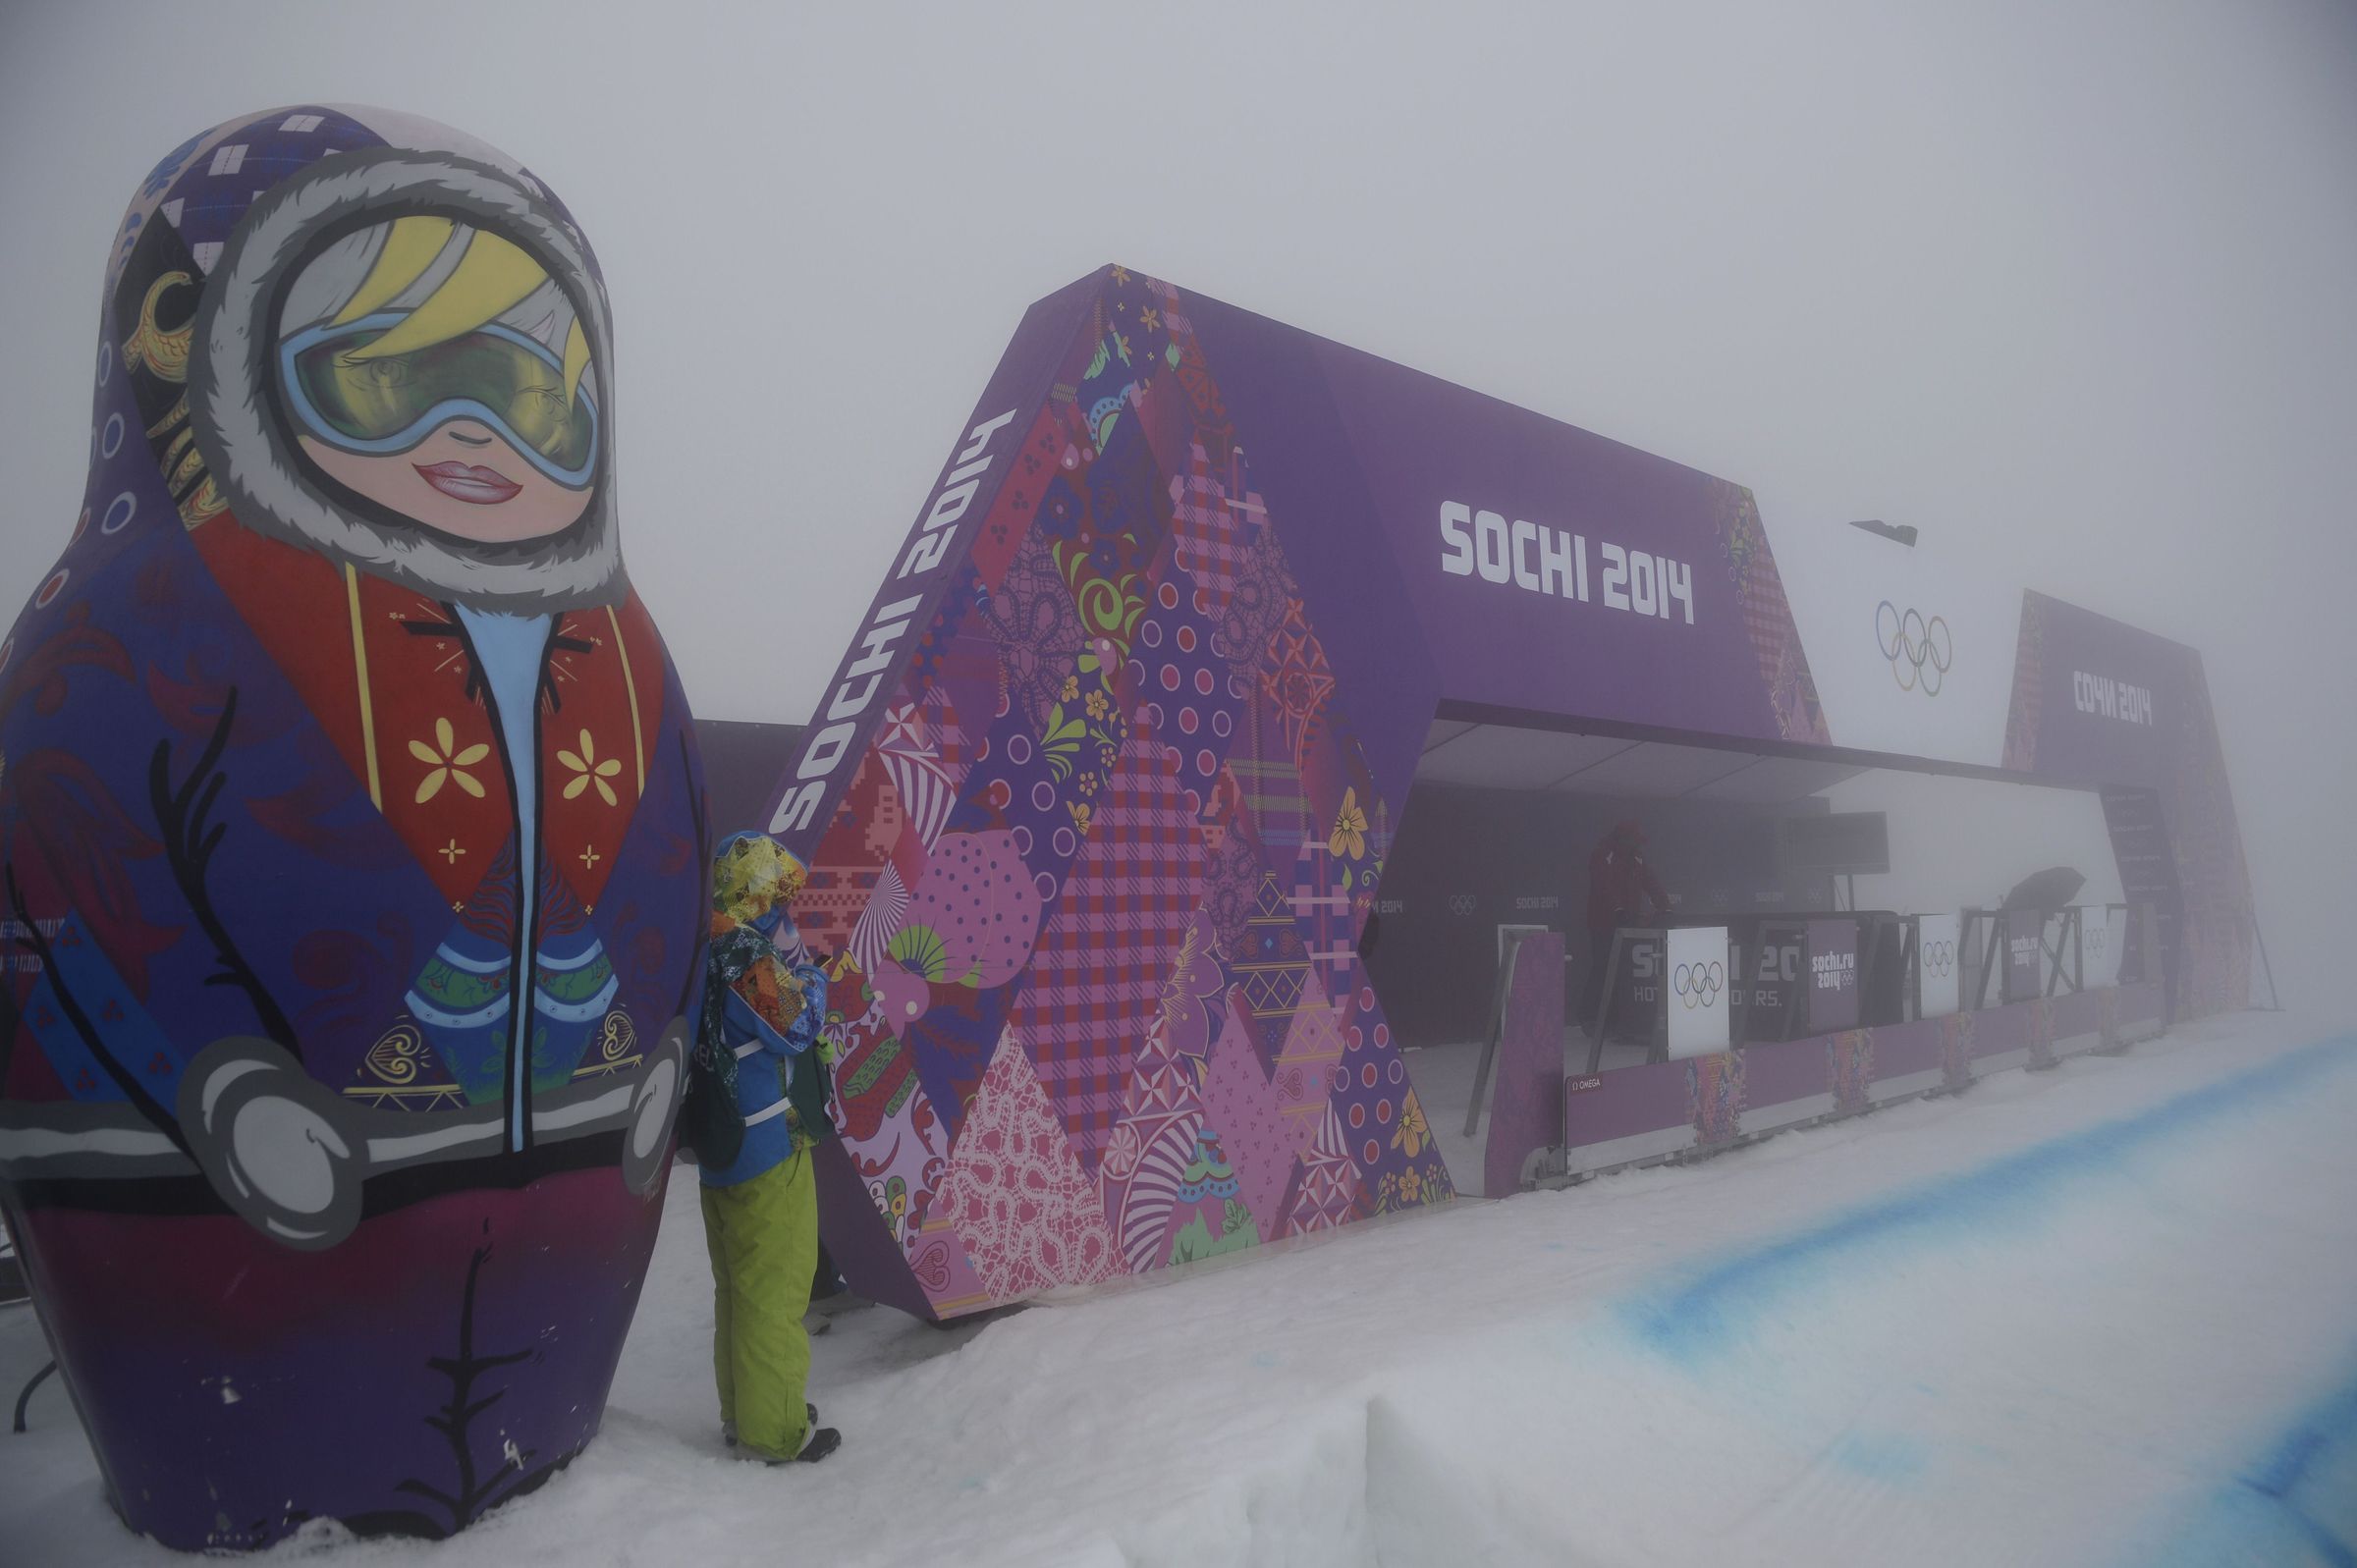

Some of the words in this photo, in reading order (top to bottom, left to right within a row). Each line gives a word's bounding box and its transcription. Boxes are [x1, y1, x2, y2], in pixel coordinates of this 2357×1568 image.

[1440, 500, 1589, 603] SOCHI
[1601, 541, 1695, 625] 2014
[769, 593, 923, 835] SOCHI
[897, 408, 1017, 580] 2014
[2073, 670, 2118, 720] СОЧИ
[2117, 681, 2153, 728] 2014
[1381, 899, 1403, 914] 2014
[1516, 895, 1540, 910] SOCHI
[1540, 894, 1560, 909] 2014
[1811, 950, 1854, 973] sochi.ru
[1817, 972, 1840, 992] 2014
[1578, 1077, 1601, 1090] OMEGA
